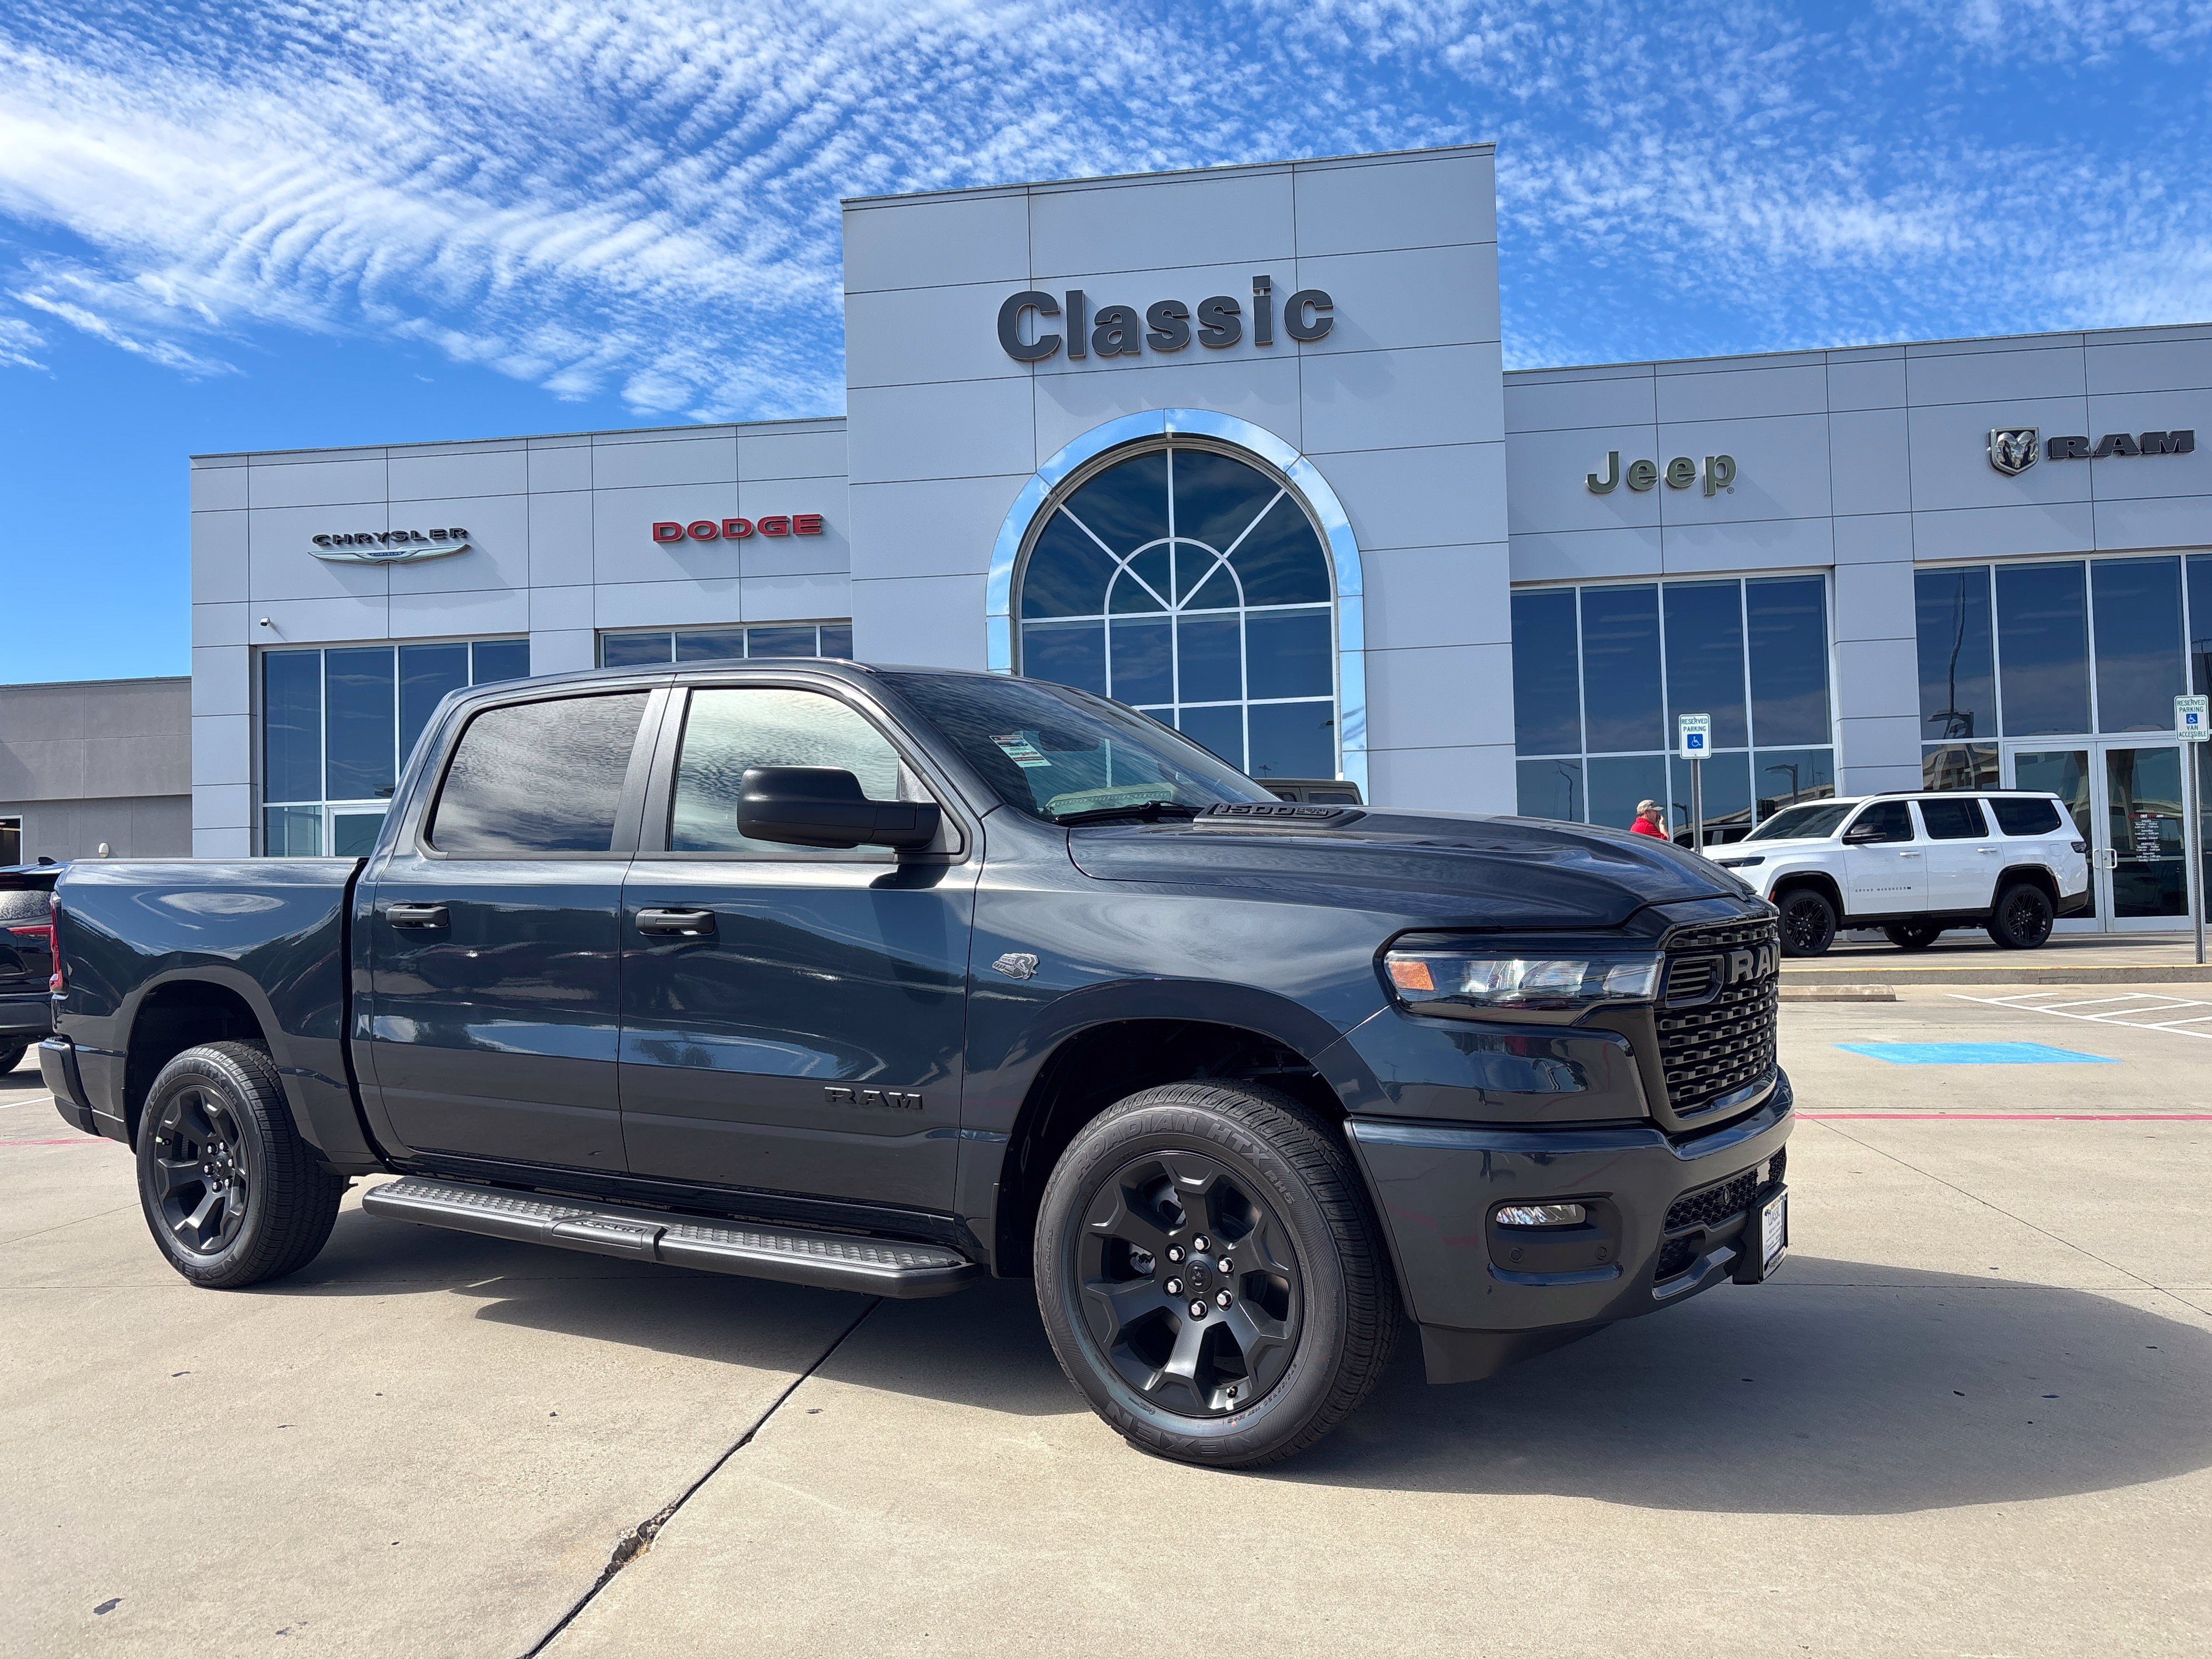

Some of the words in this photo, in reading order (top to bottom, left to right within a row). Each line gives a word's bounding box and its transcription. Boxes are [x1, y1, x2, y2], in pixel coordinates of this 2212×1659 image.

[996, 274, 1335, 362] Classic
[2047, 430, 2196, 459] RAM
[1585, 450, 1737, 496] Jeep
[312, 527, 469, 545] CHRYSLER
[652, 514, 823, 542] DODGE
[1215, 804, 1295, 816] 1500
[1728, 943, 1781, 984] RAM
[198, 1062, 227, 1086] HTX
[824, 1086, 923, 1110] RAM
[1073, 1114, 1199, 1180] ROADIAN
[1207, 1123, 1271, 1169] HTX
[1264, 1170, 1295, 1205] RH5
[172, 1253, 239, 1280] NEXEN
[1104, 1401, 1262, 1458] NEXEN
